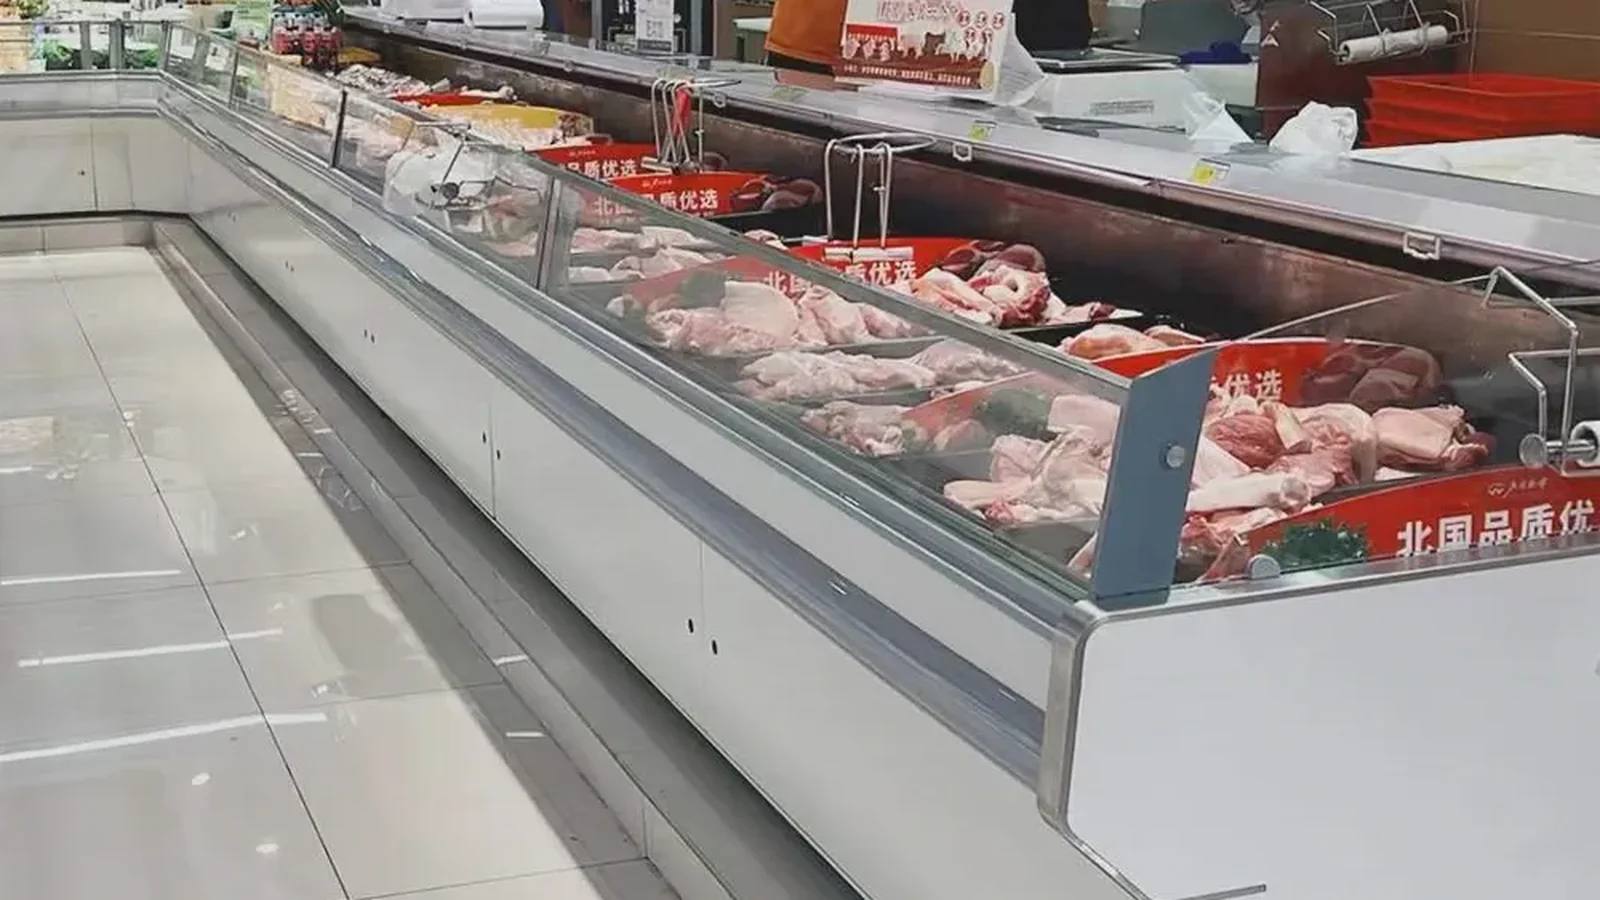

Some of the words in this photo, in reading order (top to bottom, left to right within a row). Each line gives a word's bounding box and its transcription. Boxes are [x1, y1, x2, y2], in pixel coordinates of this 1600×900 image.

[1209, 369, 1282, 401] 优选
[1396, 498, 1595, 557] 北国品质优
